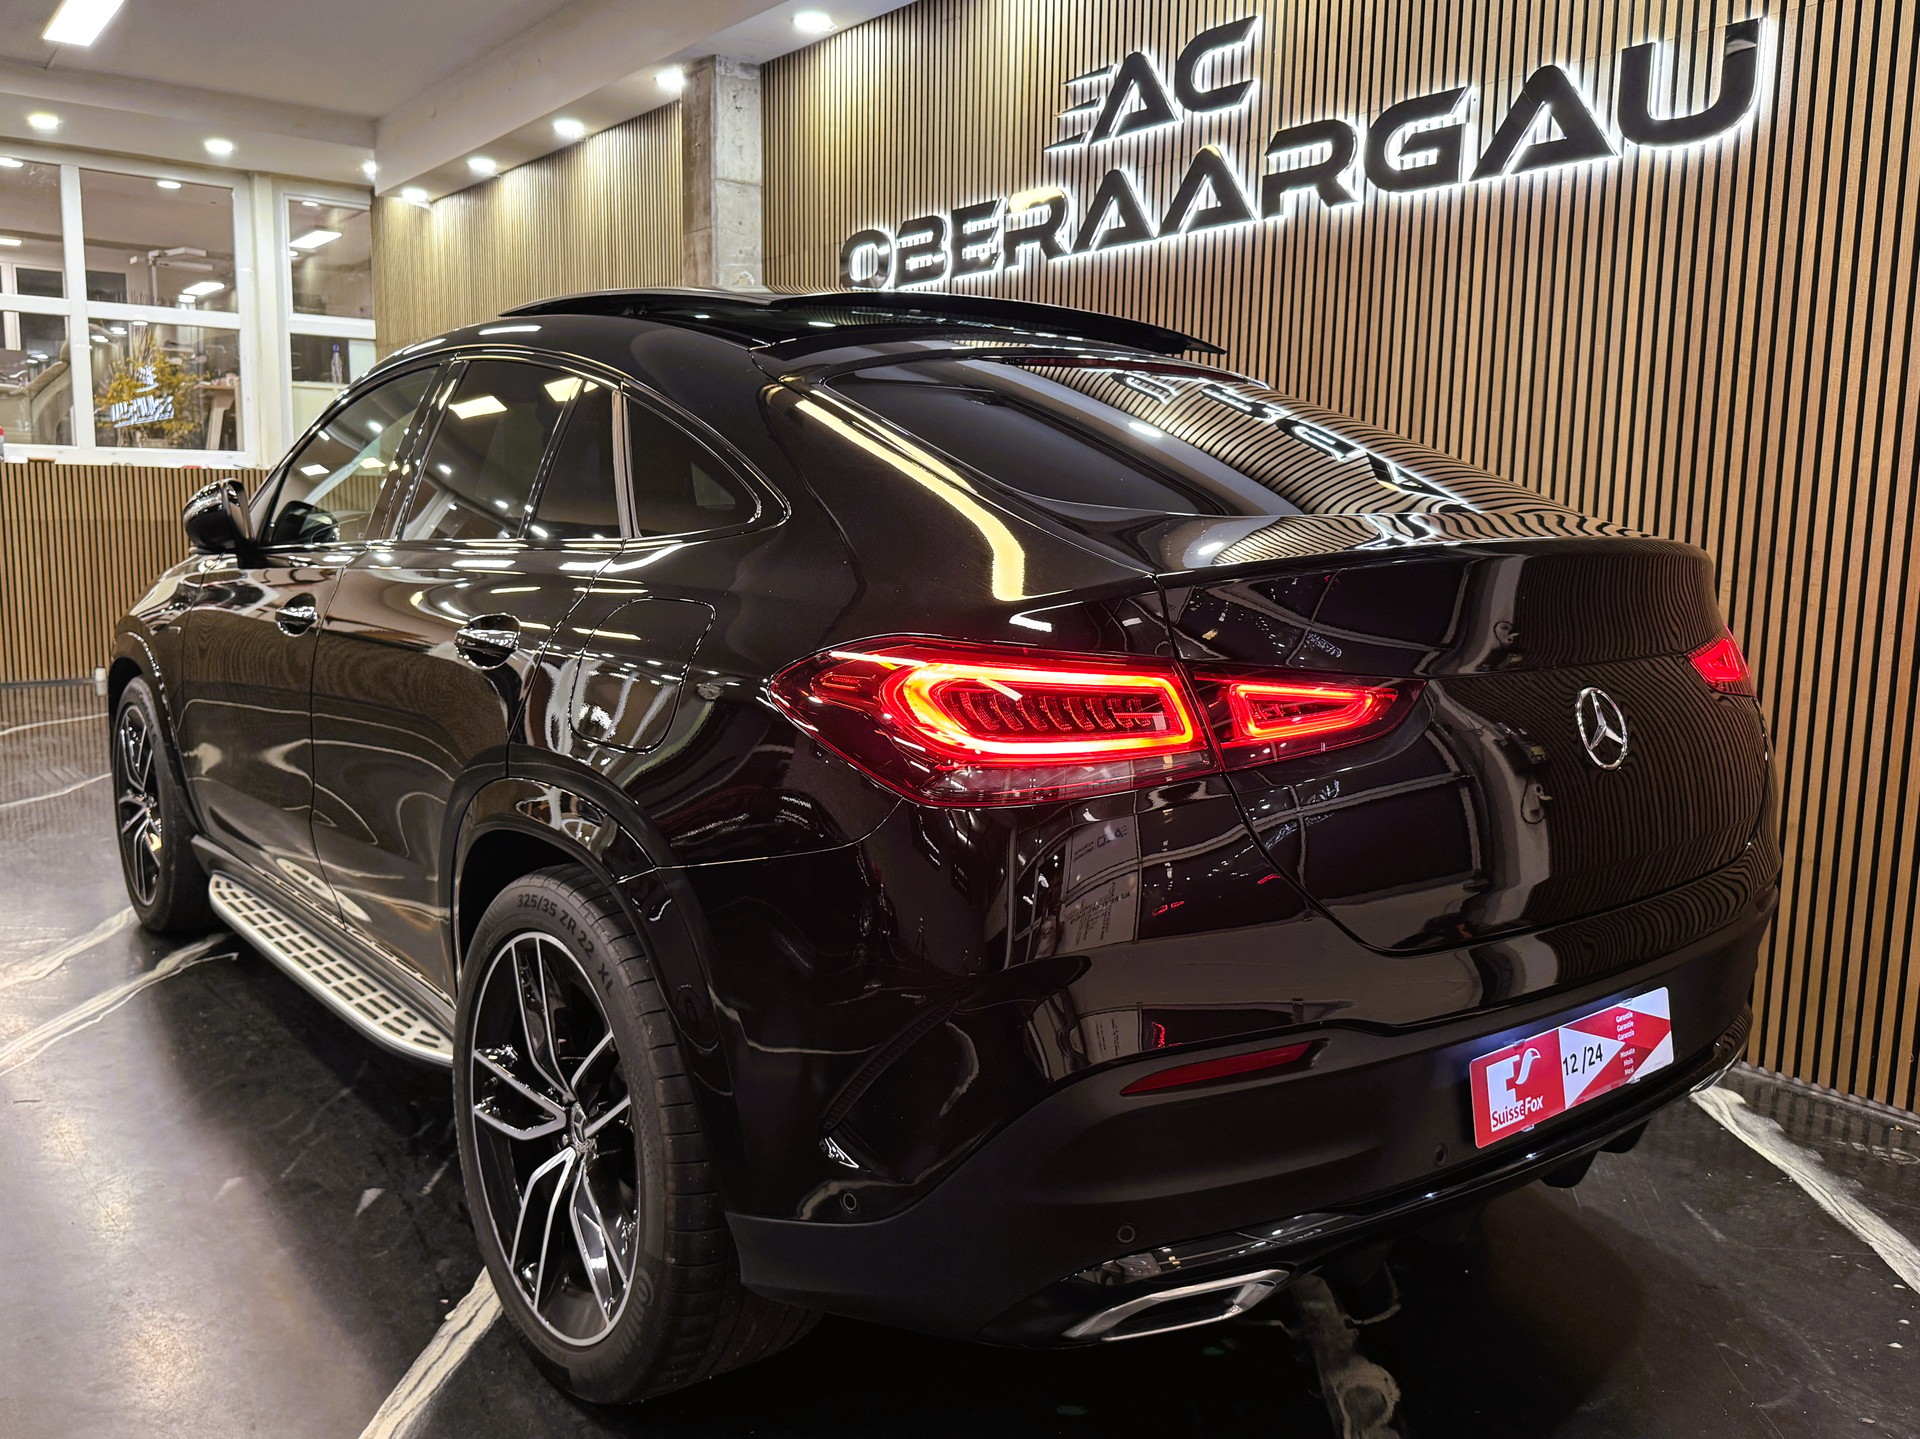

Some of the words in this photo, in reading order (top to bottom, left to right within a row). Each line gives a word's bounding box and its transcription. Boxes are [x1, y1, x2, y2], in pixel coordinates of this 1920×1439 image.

[840, 17, 1763, 292] OBERAARGAU
[517, 894, 558, 917] 325/35
[559, 910, 577, 935] ZR
[576, 930, 595, 959] 22
[597, 962, 614, 998] XL
[1491, 1095, 1544, 1128] SuisseFox
